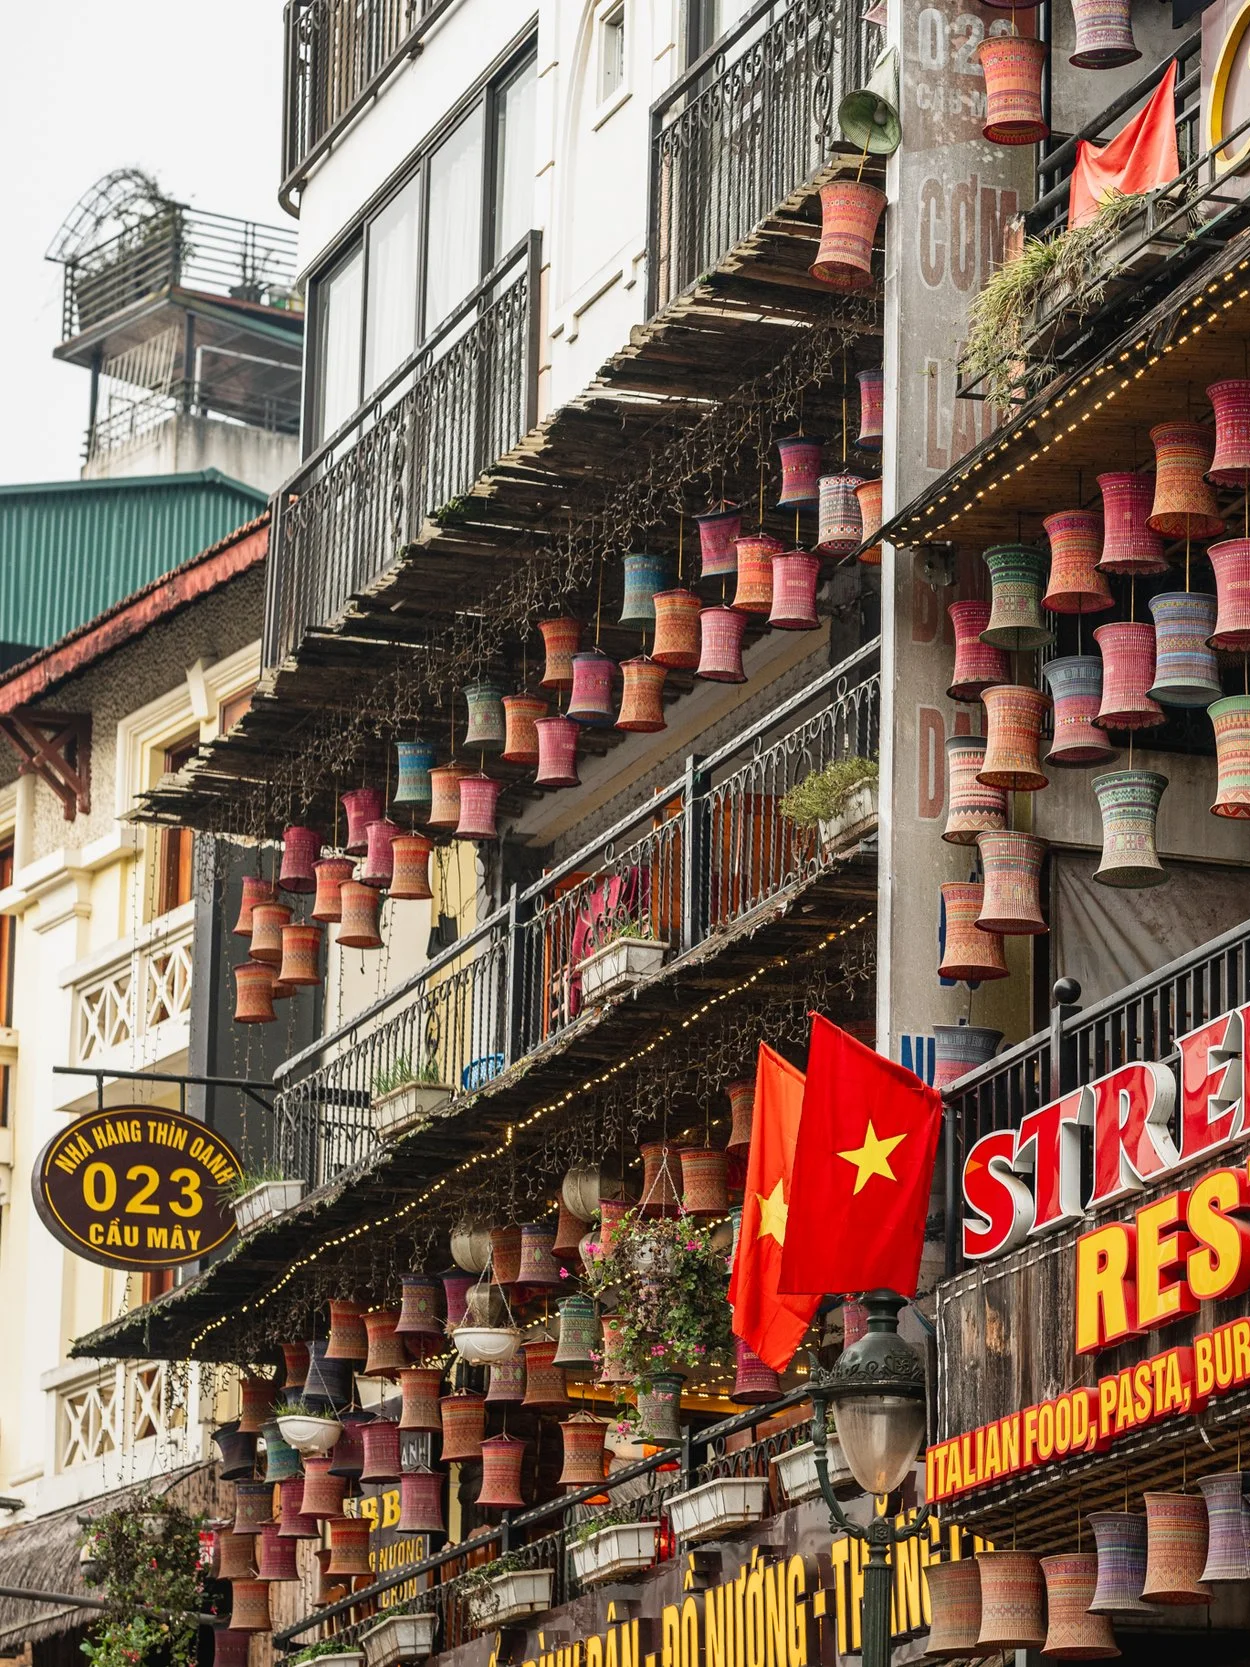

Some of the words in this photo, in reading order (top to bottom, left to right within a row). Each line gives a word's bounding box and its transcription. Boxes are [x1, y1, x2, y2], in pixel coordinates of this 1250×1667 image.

[918, 8, 1019, 75] 02
[55, 1132, 95, 1175] NHÀ
[92, 1119, 142, 1149] HÀNG
[148, 1120, 188, 1151] THÌN
[189, 1140, 236, 1185] OANH
[83, 1162, 203, 1218] 023
[89, 1217, 139, 1247] CẦU
[147, 1224, 201, 1250] MÂY
[926, 1412, 1021, 1504] ITALIAN
[1024, 1388, 1097, 1465] FOOD,
[1100, 1347, 1192, 1438] PASTA,
[360, 1489, 401, 1533] BB
[831, 1494, 941, 1655] THNG
